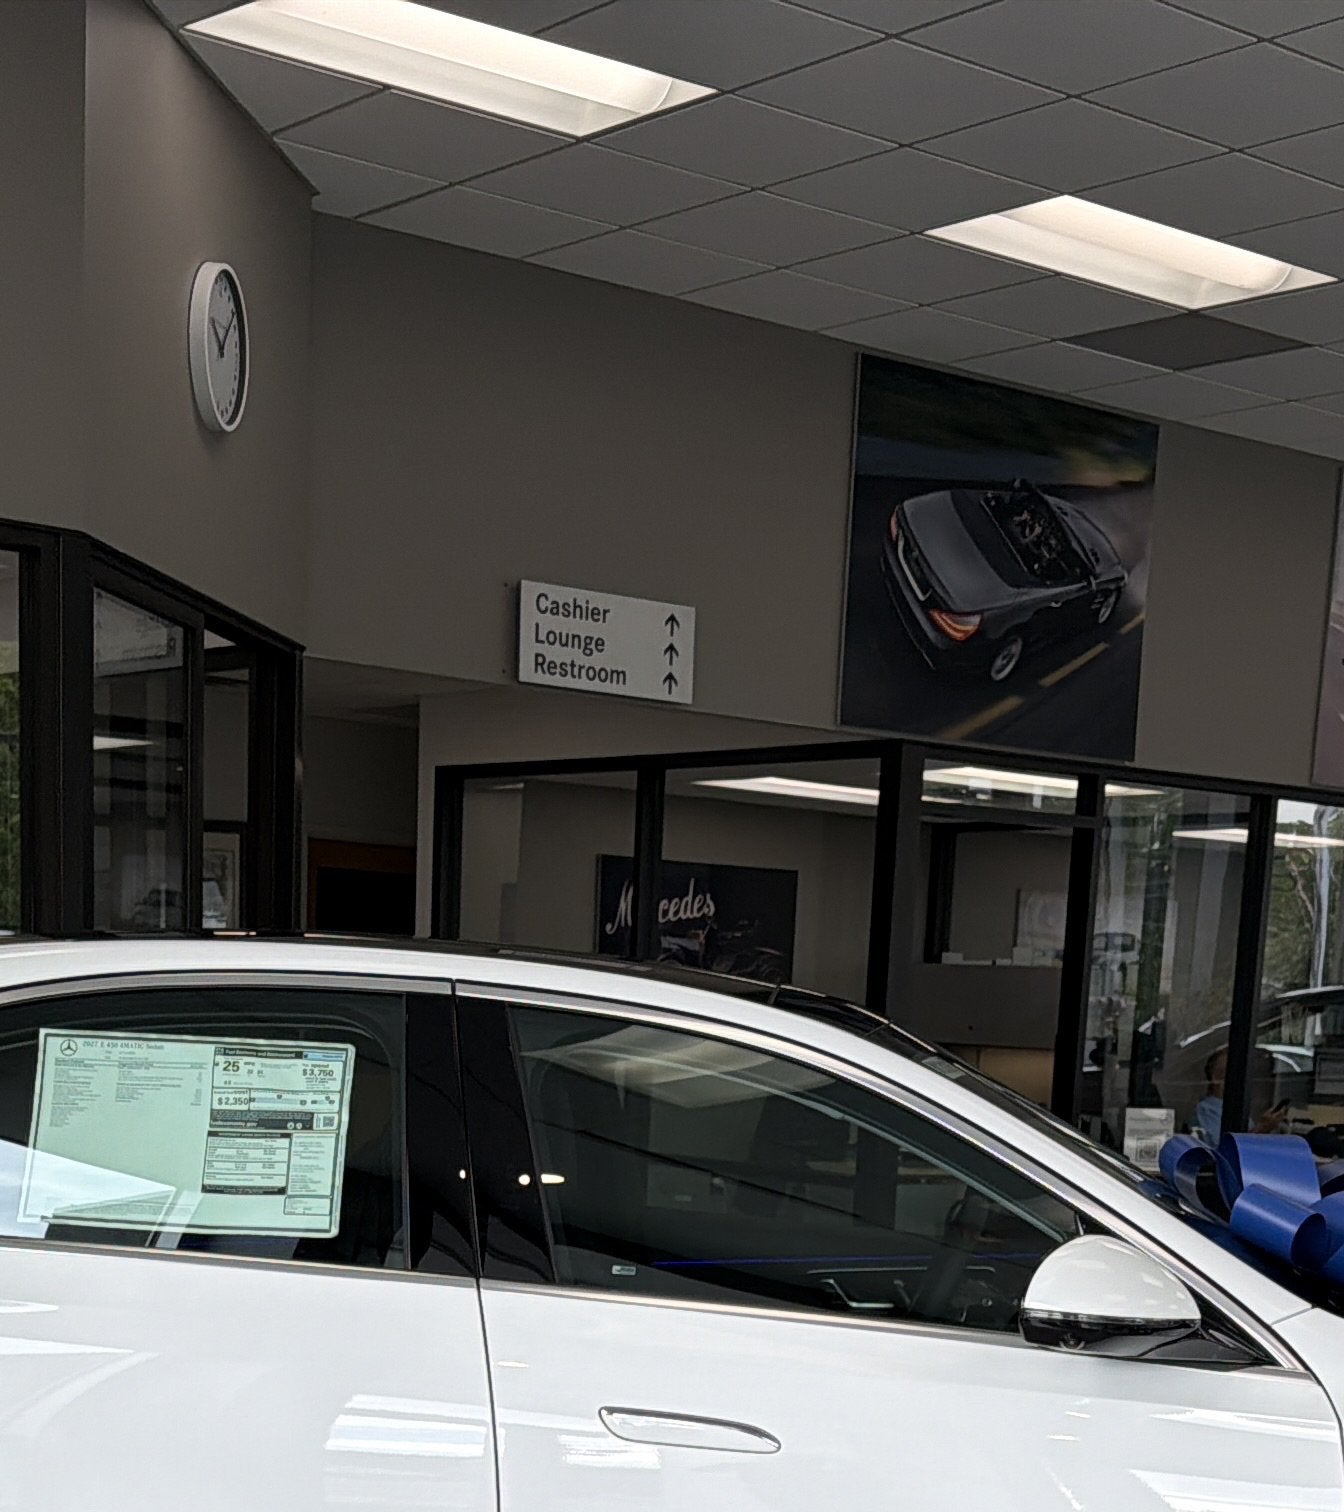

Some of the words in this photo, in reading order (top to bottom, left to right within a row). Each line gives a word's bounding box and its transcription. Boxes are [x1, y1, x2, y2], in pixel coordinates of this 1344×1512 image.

[536, 592, 611, 623] Cashier
[534, 622, 605, 657] Lounge
[534, 652, 627, 685] Restroom
[605, 877, 716, 935] Mcedes
[222, 1060, 241, 1072] 25
